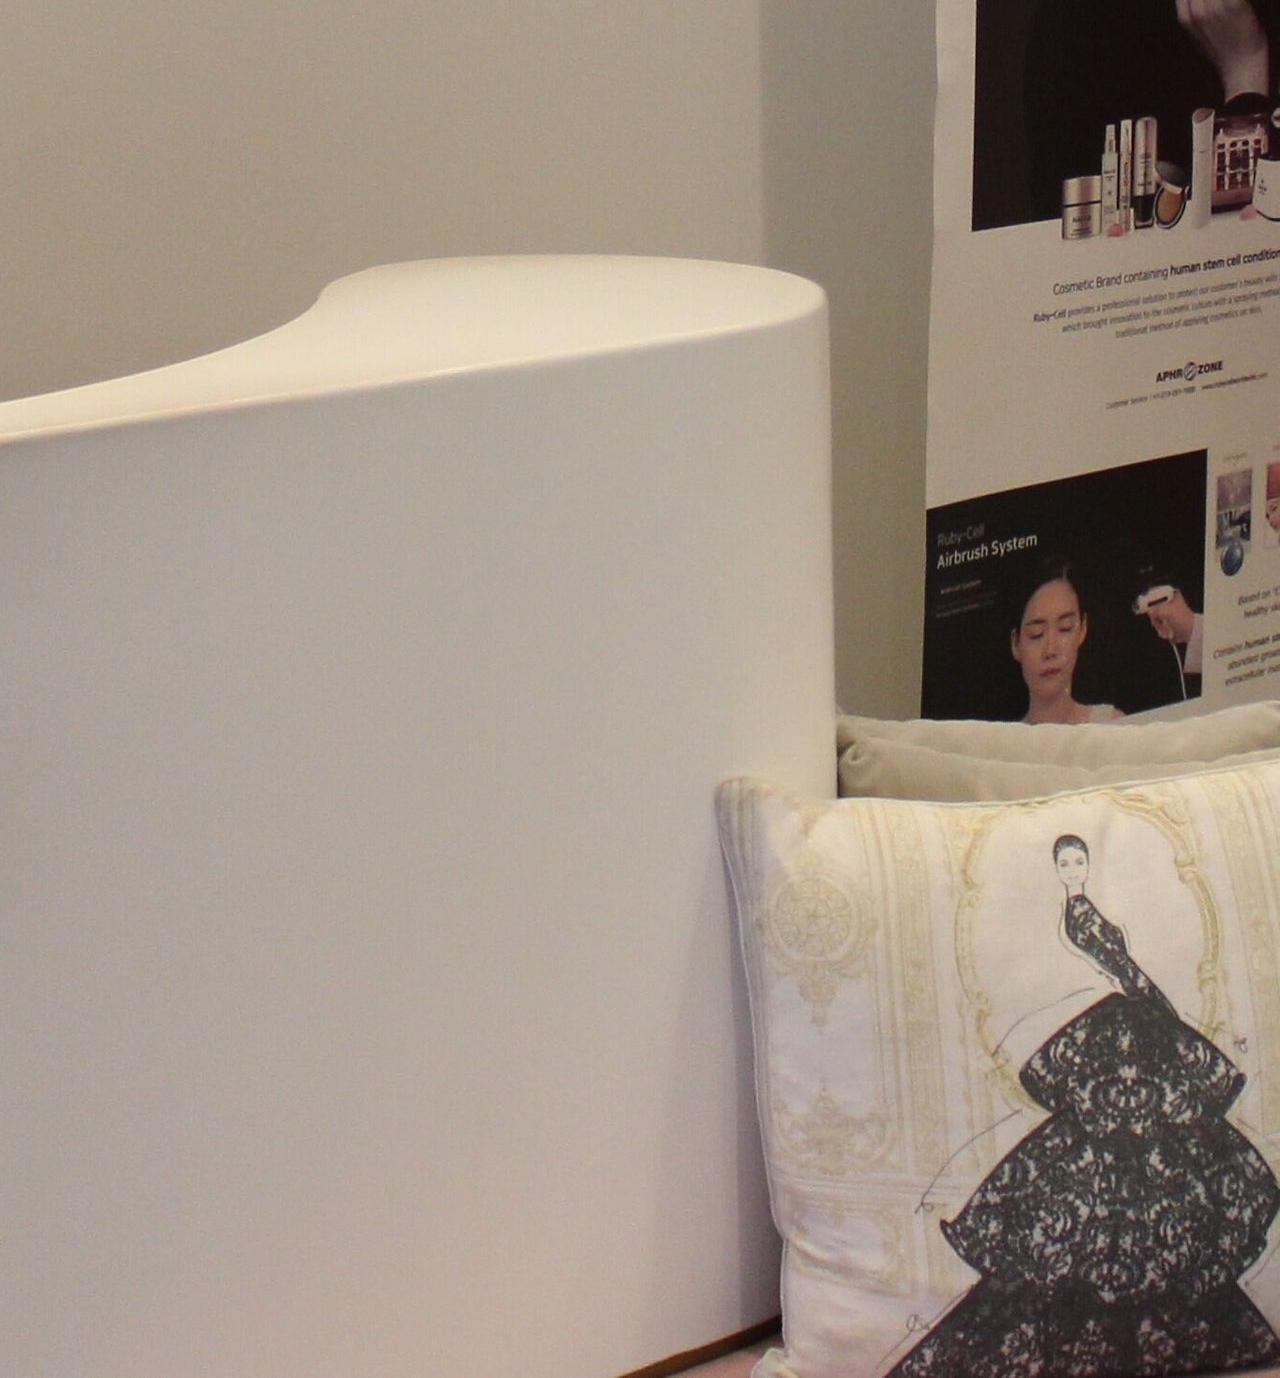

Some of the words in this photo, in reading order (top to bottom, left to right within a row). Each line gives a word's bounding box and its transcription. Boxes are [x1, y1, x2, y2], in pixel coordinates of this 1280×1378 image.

[1053, 279, 1095, 295] Cosmetic
[1096, 273, 1122, 288] Brand
[1123, 267, 1169, 284] containing
[1170, 263, 1201, 275] human
[1202, 258, 1225, 270] stem
[1226, 254, 1242, 267] cell
[937, 522, 985, 548] Ruby-Cell
[936, 542, 988, 570] Airbrush
[991, 534, 1038, 558] System
[1244, 635, 1270, 649] human
